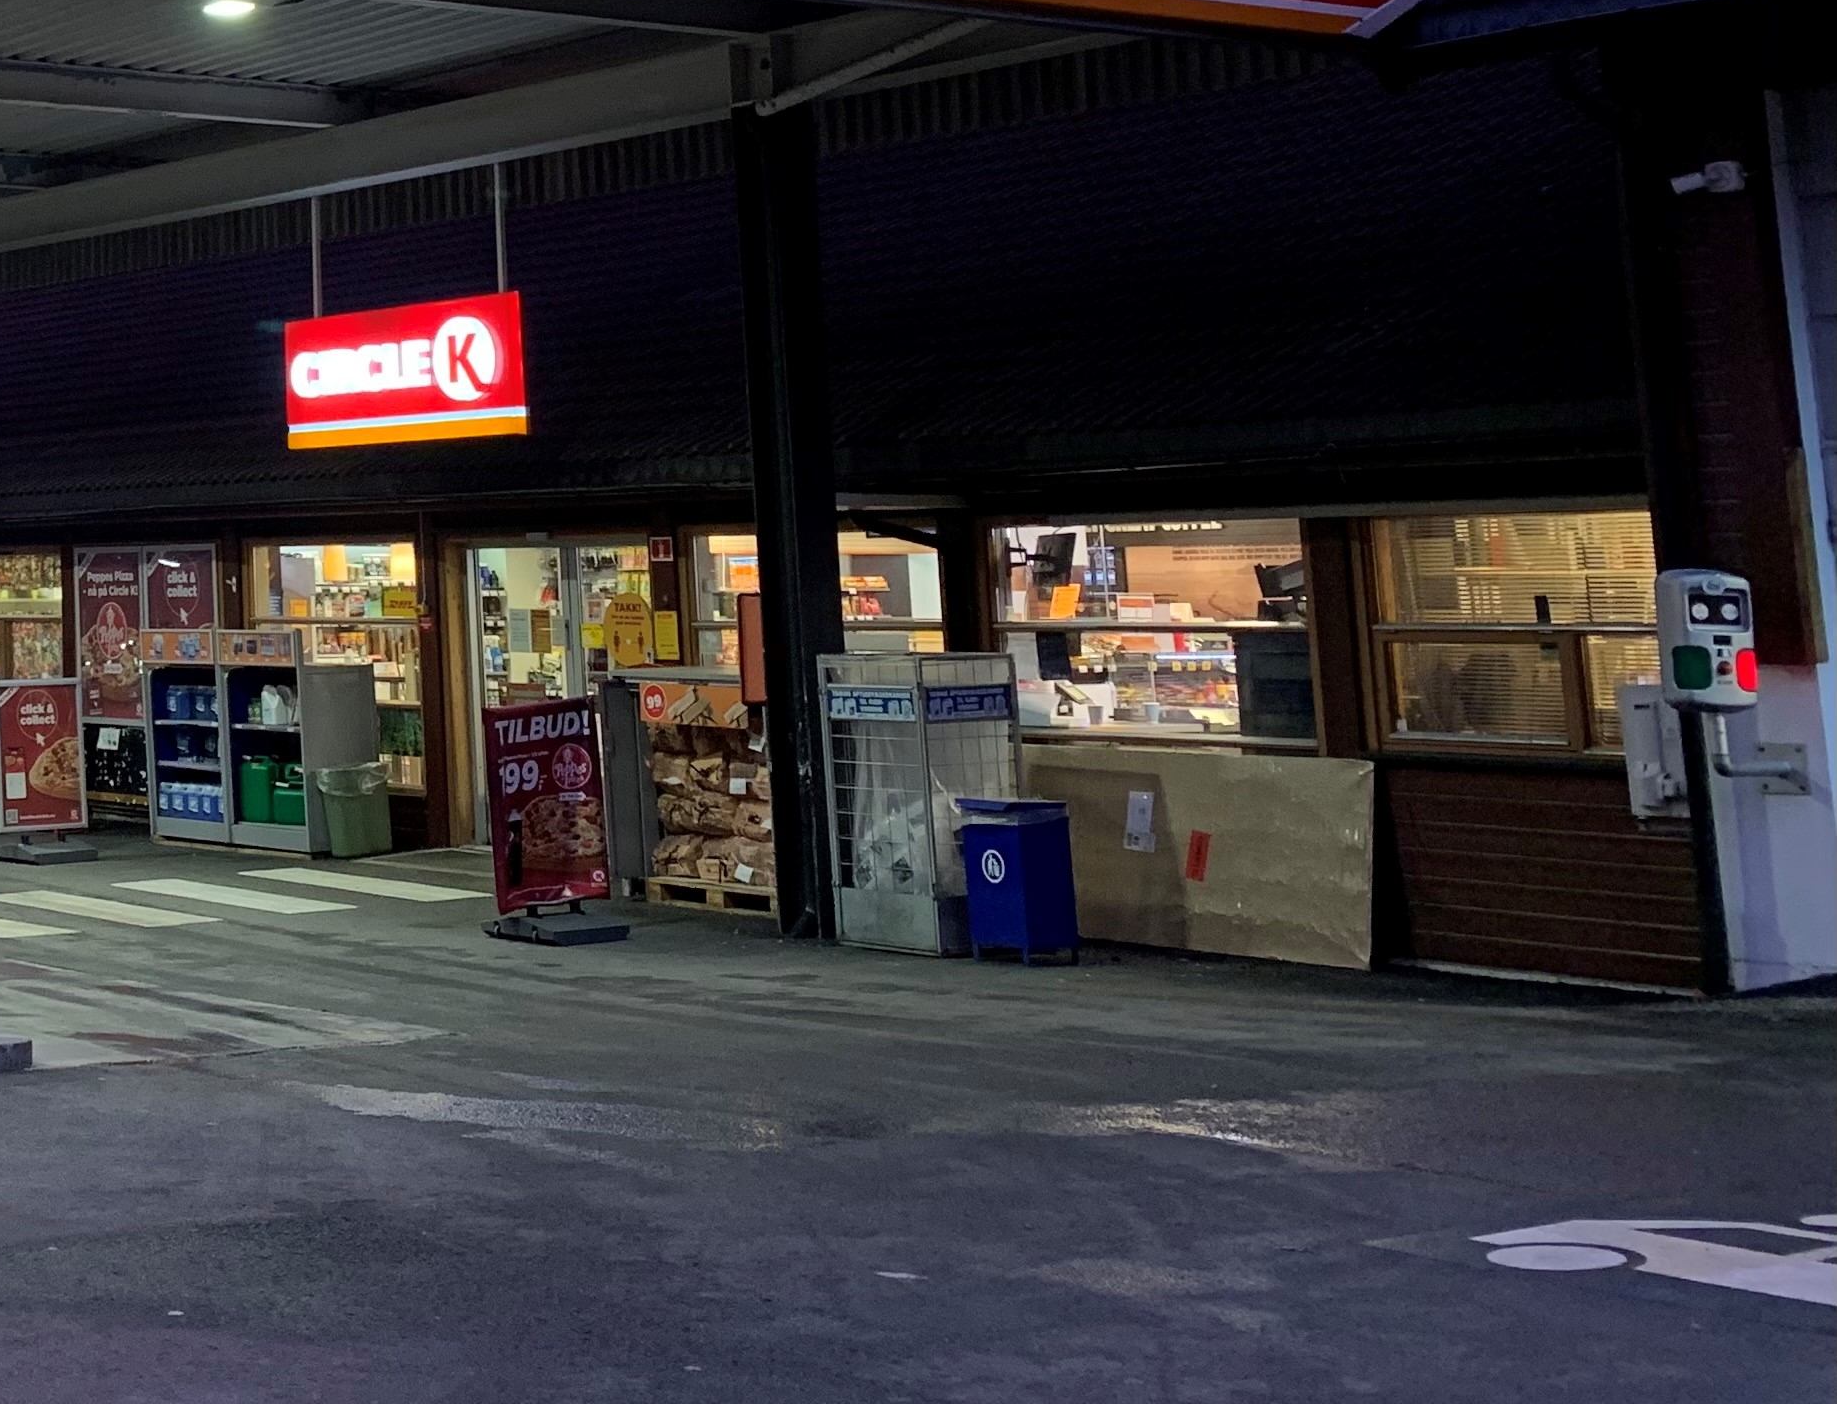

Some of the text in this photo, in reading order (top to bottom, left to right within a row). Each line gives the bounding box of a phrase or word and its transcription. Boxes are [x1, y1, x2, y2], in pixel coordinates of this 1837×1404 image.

[290, 332, 490, 399] CCLE K
[114, 570, 134, 582] Pizza
[167, 570, 196, 584] click &
[108, 585, 129, 596] Circle
[166, 584, 198, 598] collect
[389, 599, 413, 609] DHL
[646, 694, 662, 709] 99
[20, 703, 54, 715] click &
[19, 714, 56, 726] collect
[494, 709, 591, 747] TILBUD!
